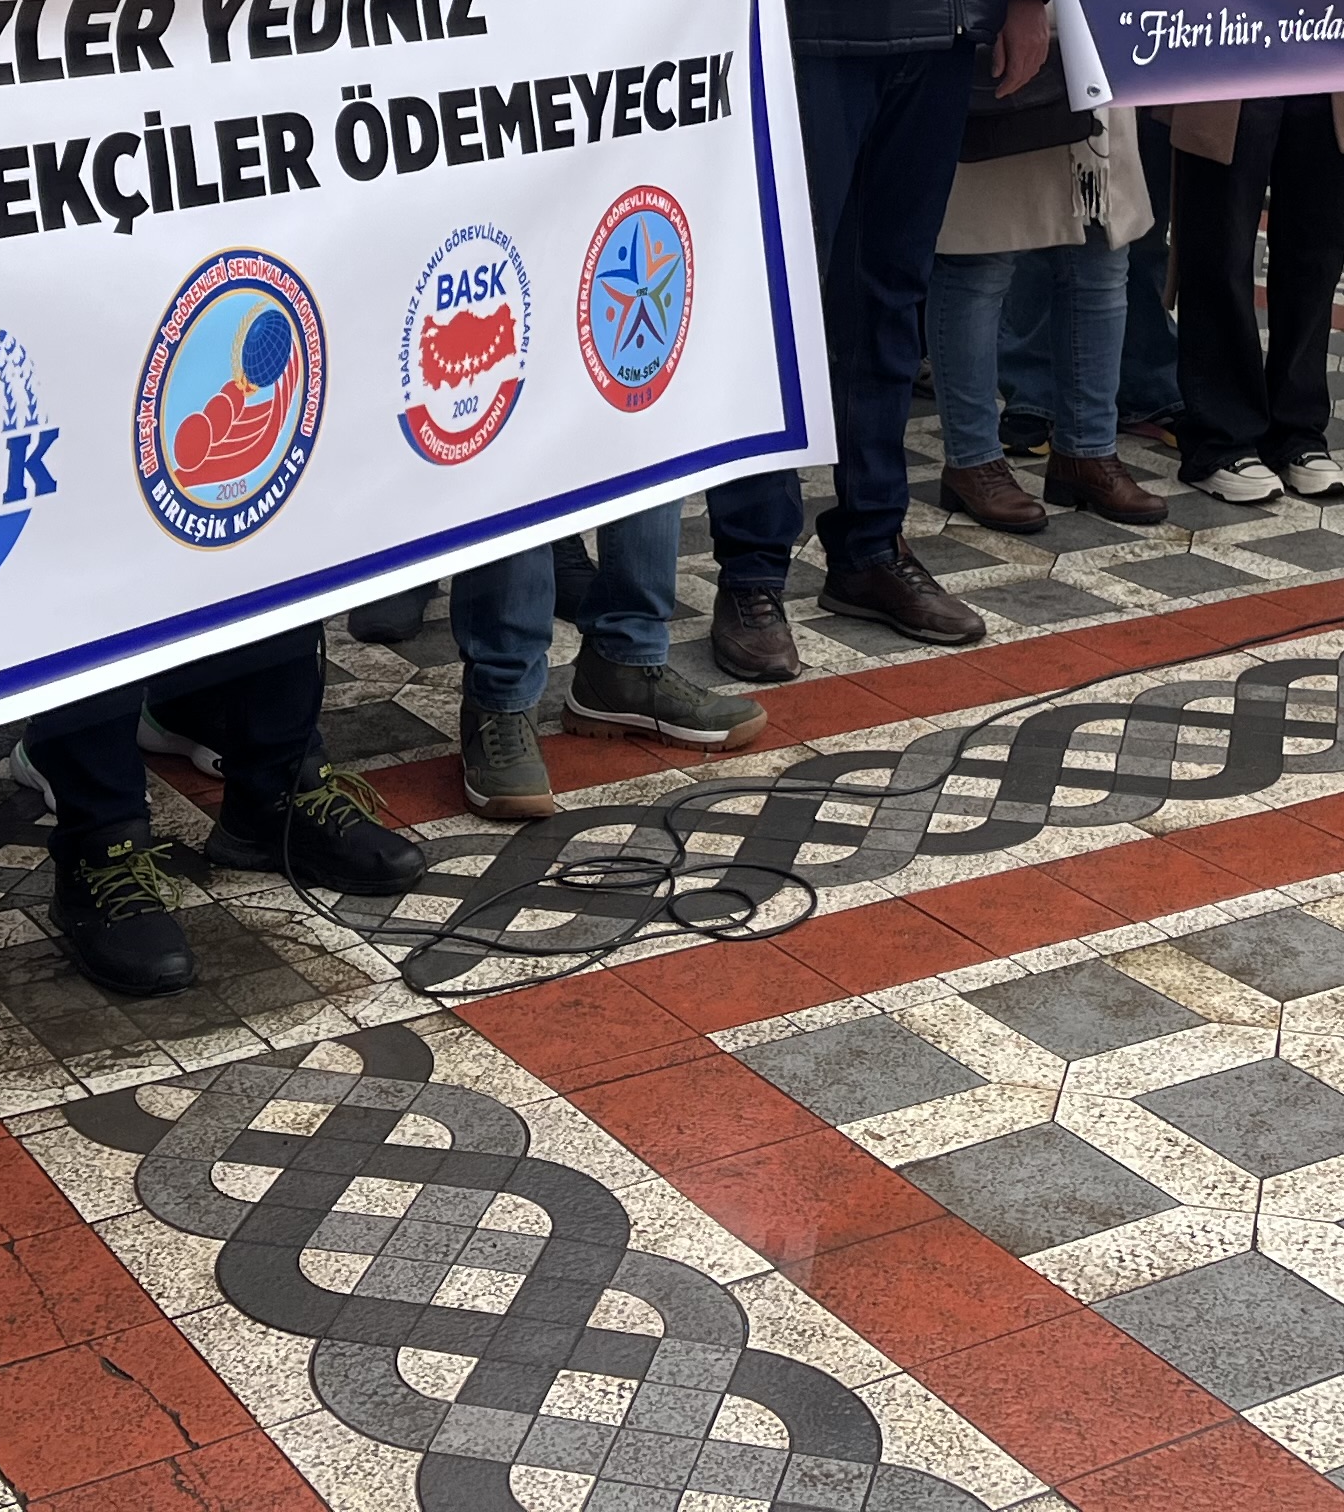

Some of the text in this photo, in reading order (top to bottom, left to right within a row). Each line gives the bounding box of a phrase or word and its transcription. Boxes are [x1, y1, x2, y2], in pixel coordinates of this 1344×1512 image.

[334, 50, 734, 182] ÖDEMEYECEK
[606, 189, 645, 227] GÖREVLİ
[645, 191, 672, 214] KAMU
[398, 221, 532, 388] BAĞIMSIZ KAMU GÖREVLİLERİ SENDİKALARI
[436, 259, 509, 312] BASK
[137, 398, 159, 480] BİRLEŞİK
[226, 253, 299, 302] SENDİKALARI
[295, 293, 324, 439] KONFEDERASYONU
[419, 393, 507, 461] KONFEDERASYONU
[452, 395, 480, 420] 2002
[151, 444, 306, 543] BİRLEŞİK KAMU-İŞ
[215, 479, 248, 502] 2008
